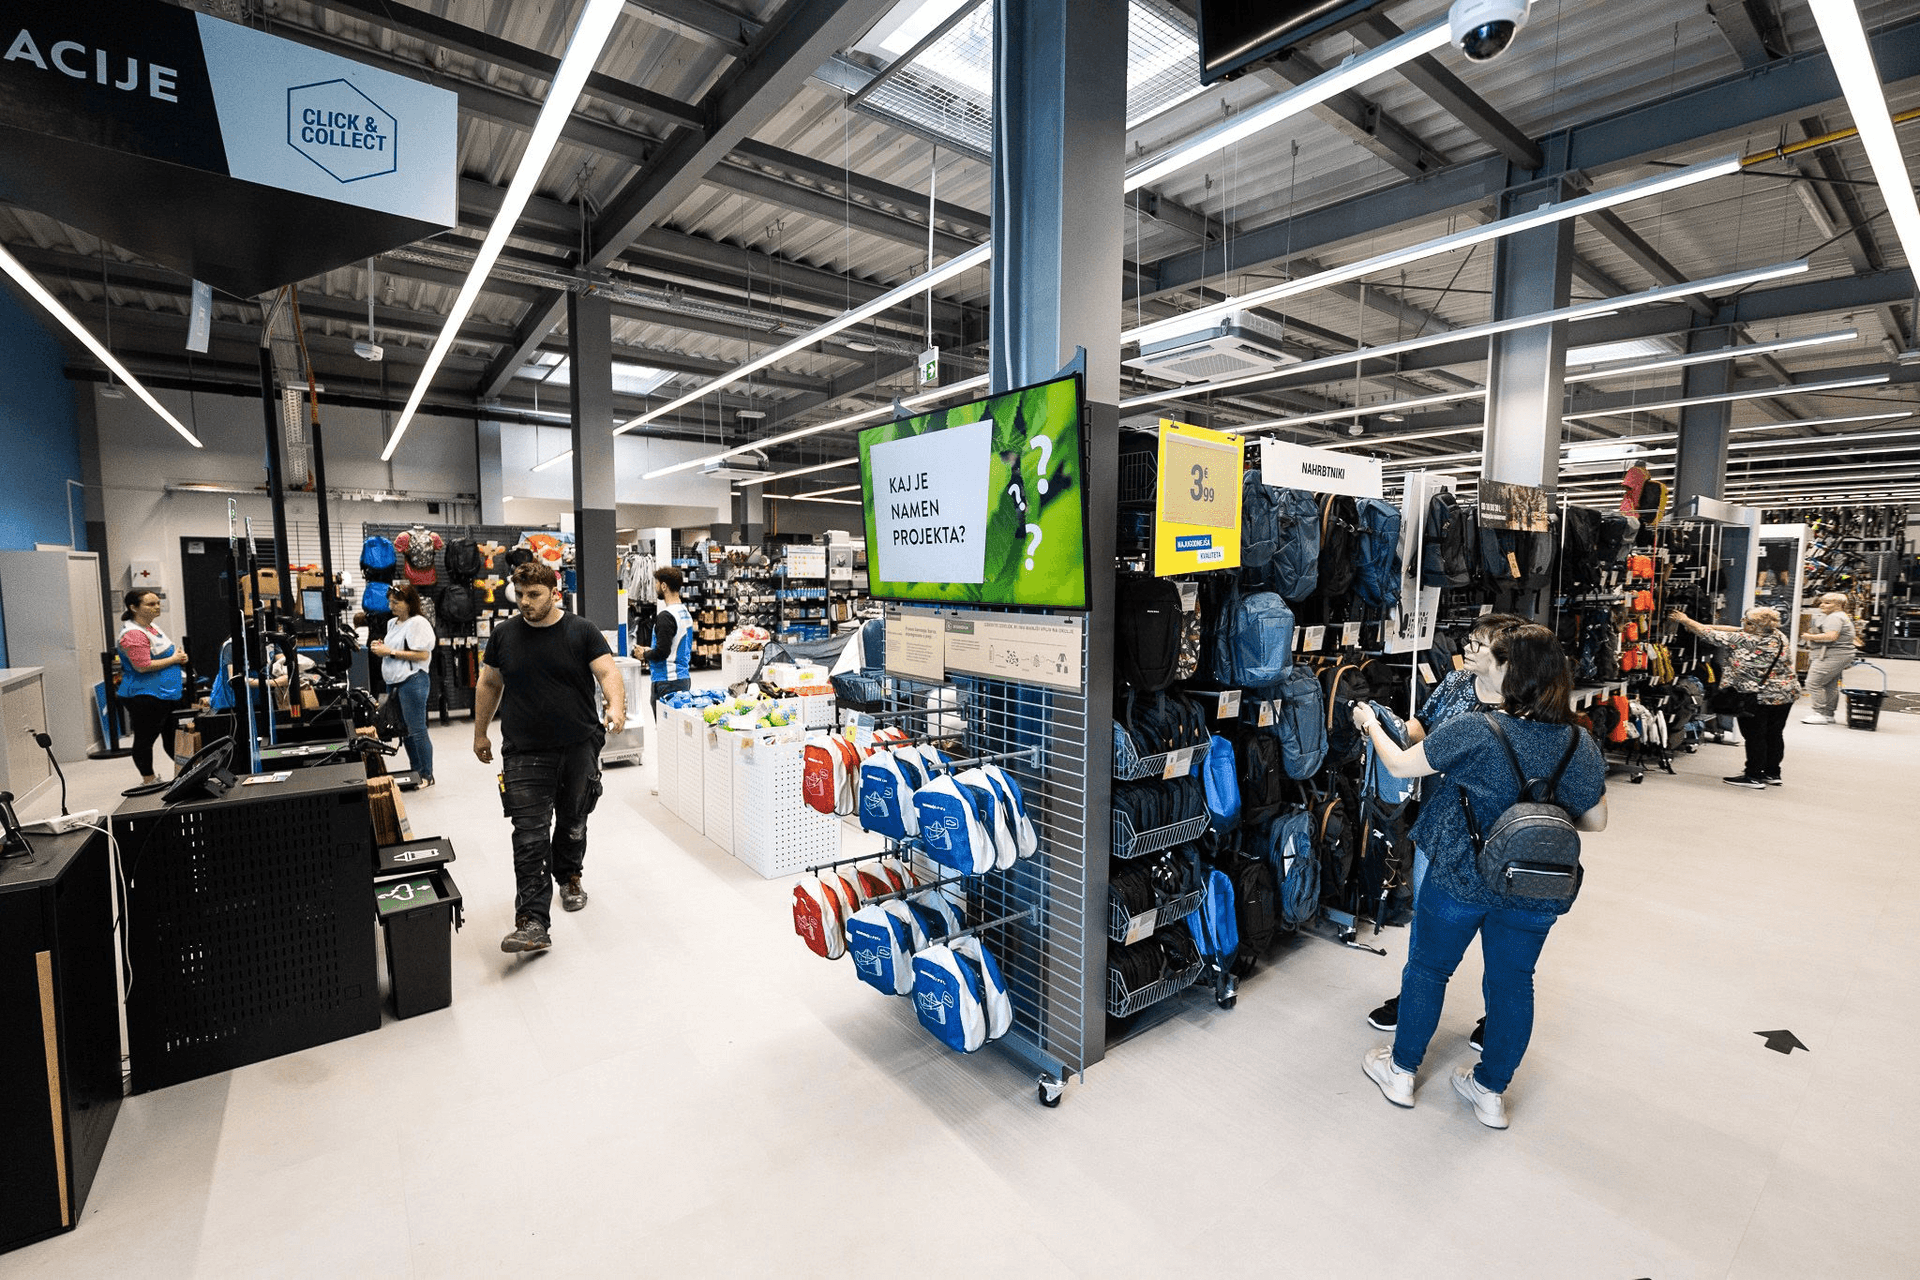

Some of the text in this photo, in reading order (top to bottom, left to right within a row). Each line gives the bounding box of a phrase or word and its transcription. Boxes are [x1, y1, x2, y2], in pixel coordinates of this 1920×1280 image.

[3, 28, 178, 103] ACIJE
[302, 108, 378, 133] CLICK &
[301, 126, 387, 151] COLLECT
[1301, 461, 1346, 480] NAHRBTNIKI
[889, 472, 929, 494] KAJ JE
[891, 498, 940, 520] NAMEN
[893, 525, 966, 546] PROJEKTA?
